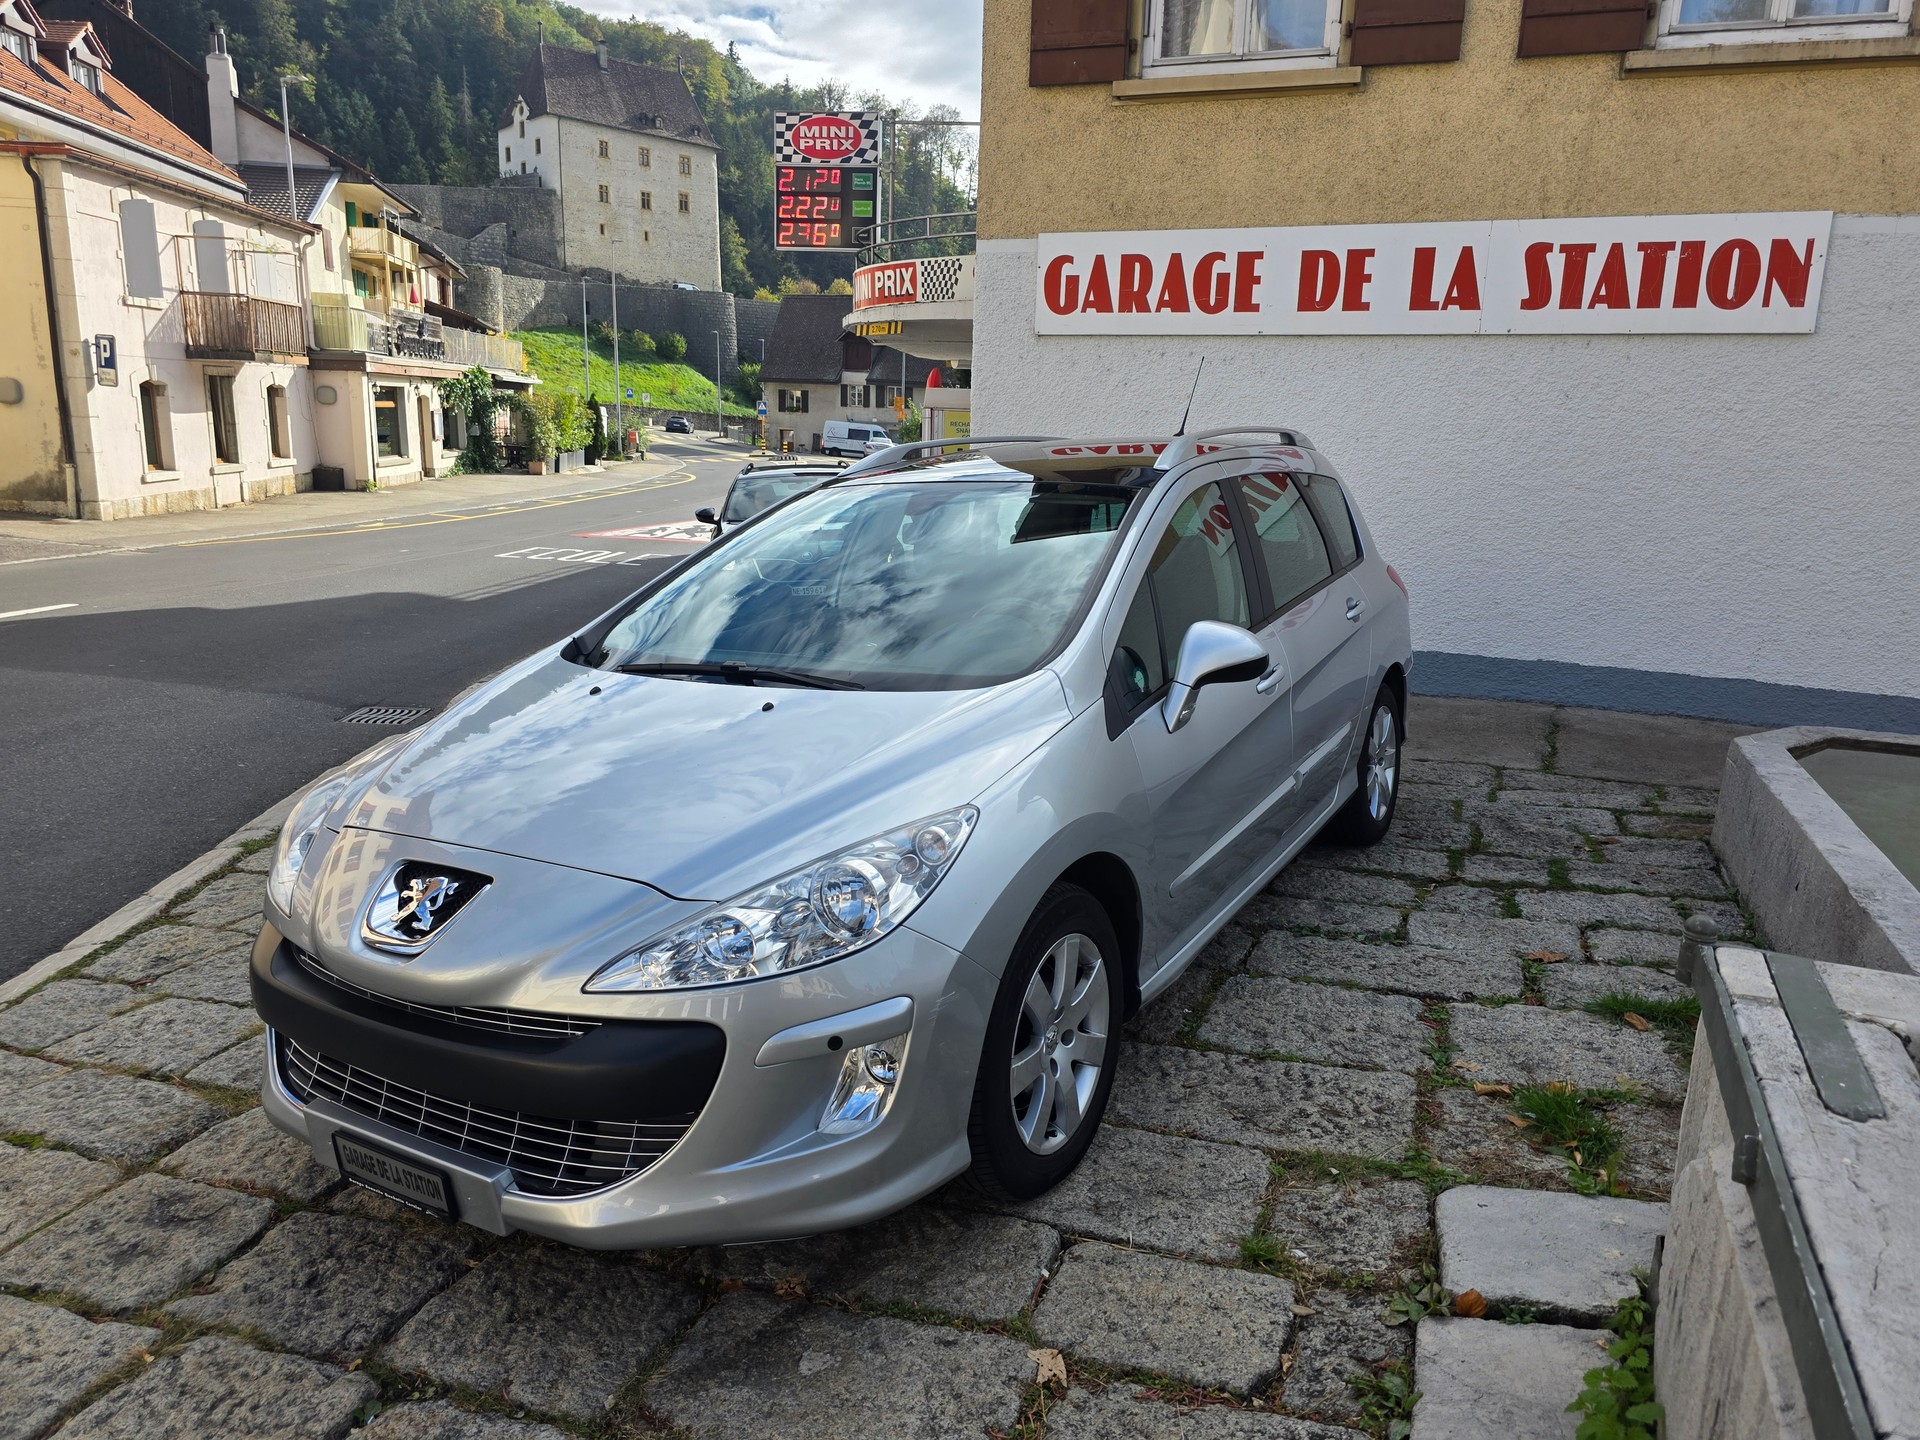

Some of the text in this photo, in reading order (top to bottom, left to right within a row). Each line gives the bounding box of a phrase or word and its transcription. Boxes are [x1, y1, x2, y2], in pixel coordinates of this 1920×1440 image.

[799, 125, 854, 138] MINI
[799, 138, 855, 151] PRIX
[874, 265, 915, 298] PRIX
[1043, 237, 1815, 315] GARAGE DE LA STATION
[99, 339, 110, 366] P
[494, 546, 673, 566] ECOLE
[342, 1144, 443, 1202] GARAGE DE LA STATION
